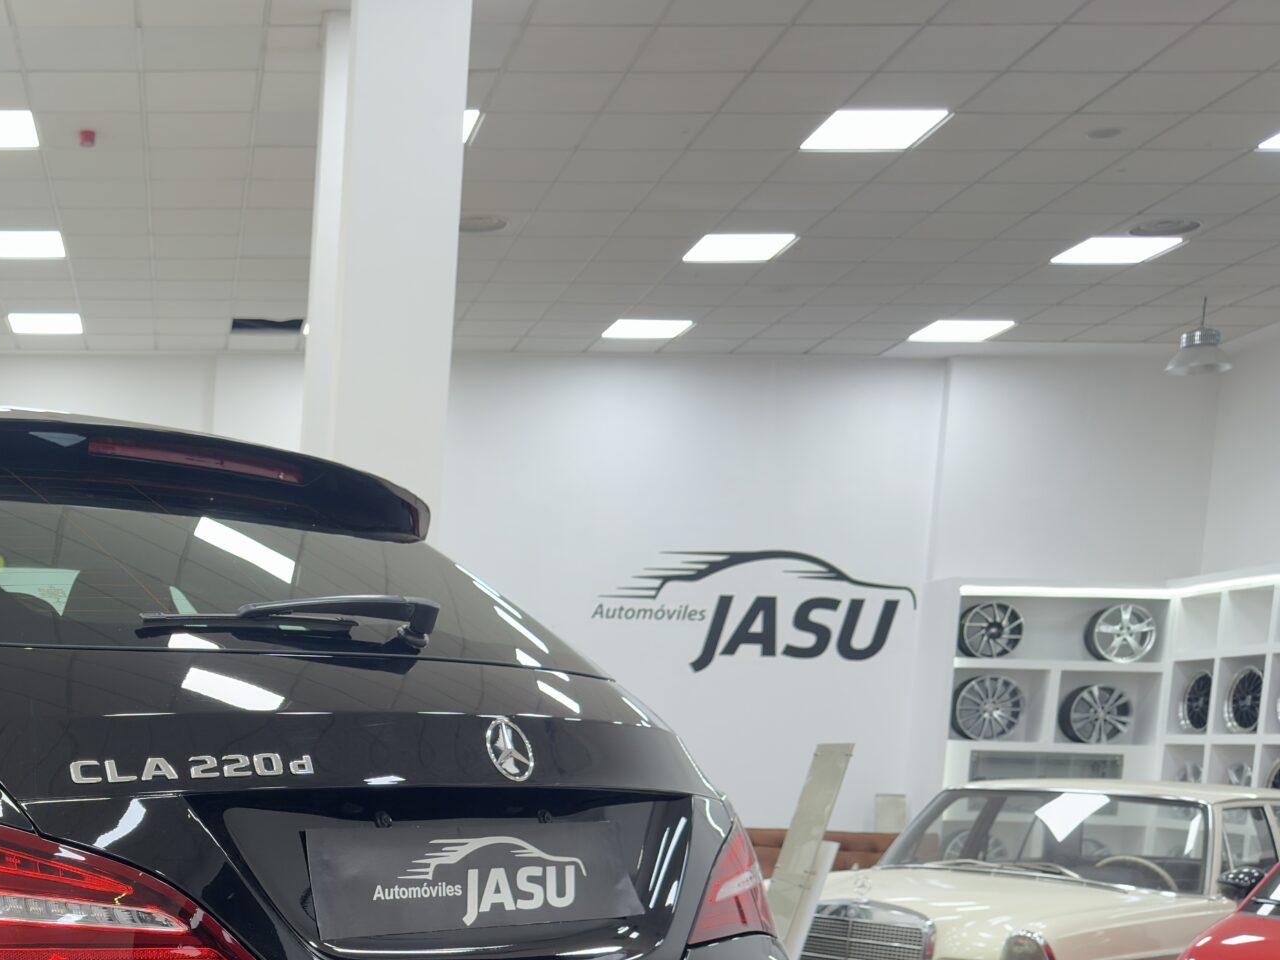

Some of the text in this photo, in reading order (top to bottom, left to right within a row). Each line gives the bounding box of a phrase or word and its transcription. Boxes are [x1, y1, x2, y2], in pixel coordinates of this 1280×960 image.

[592, 595, 900, 673] Automóviles JASU
[69, 757, 179, 784] CLA
[372, 865, 576, 927] Automóviles JASU
